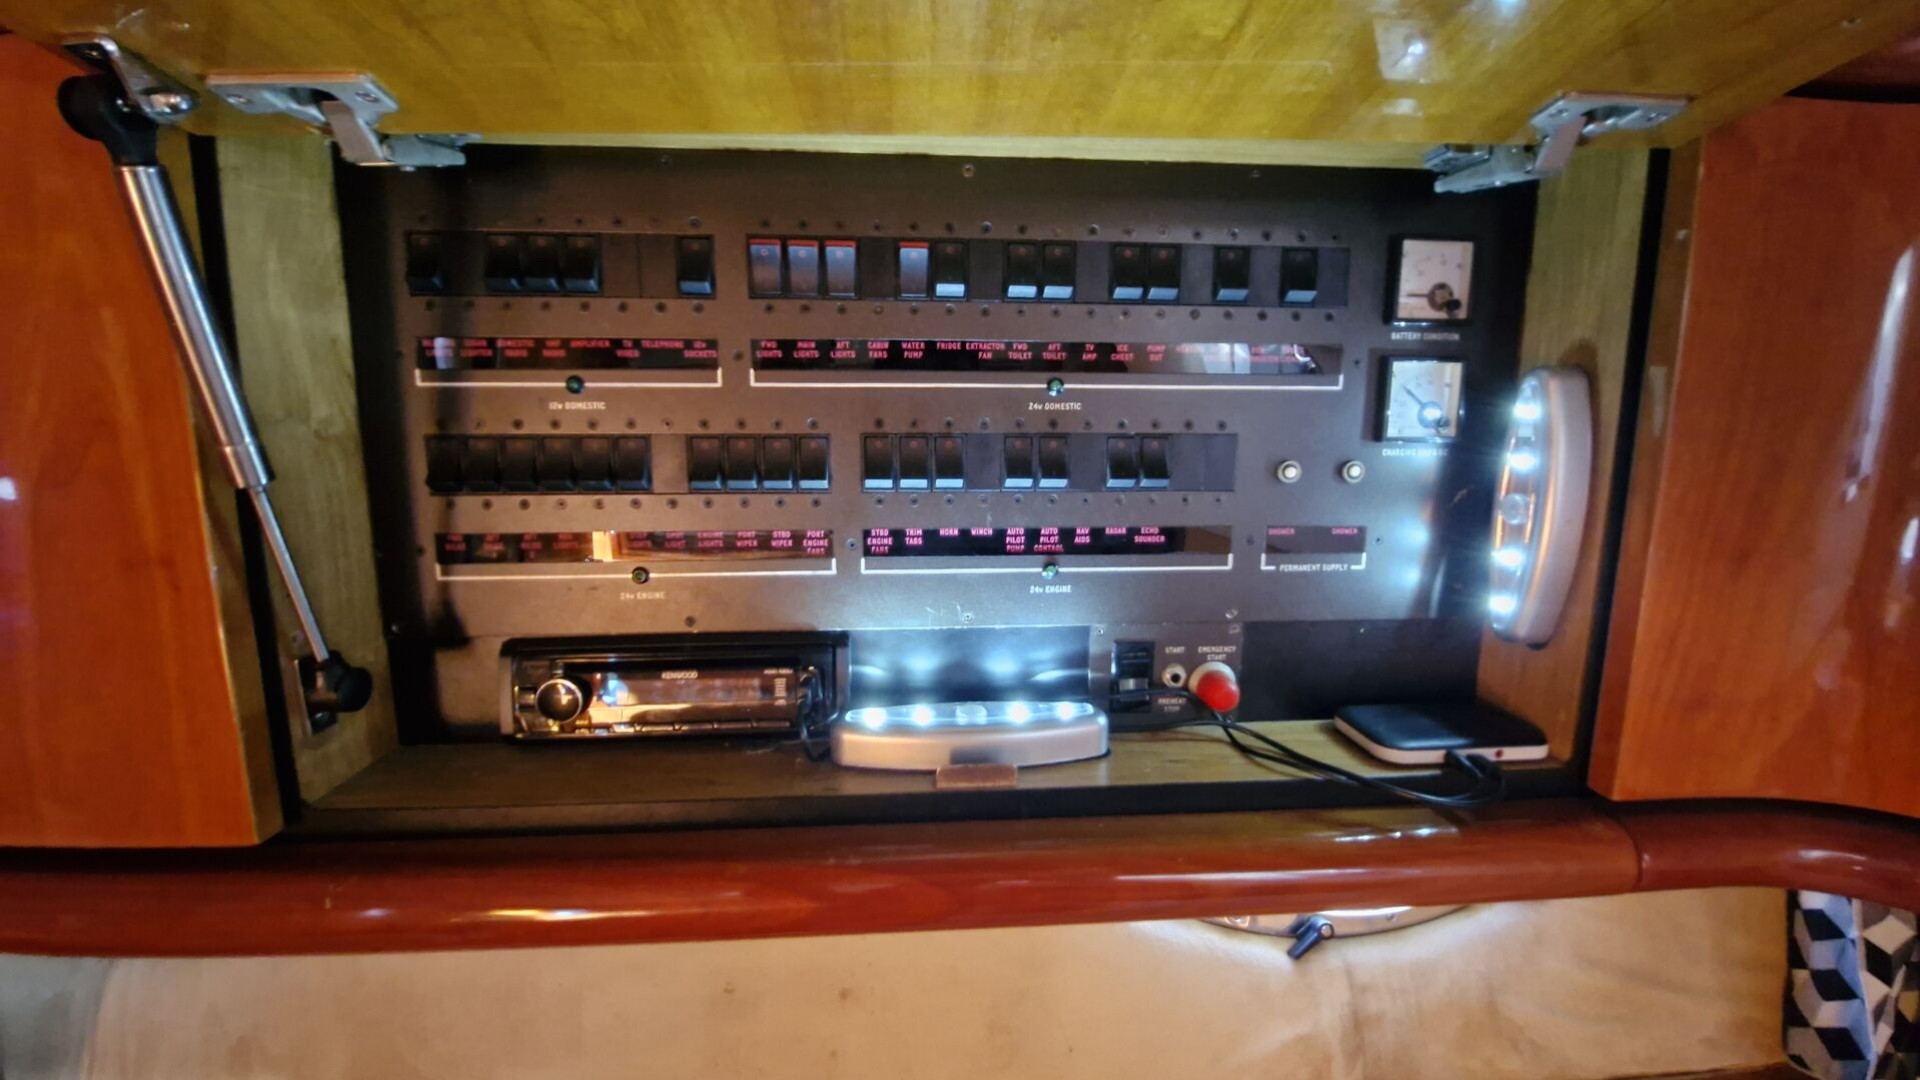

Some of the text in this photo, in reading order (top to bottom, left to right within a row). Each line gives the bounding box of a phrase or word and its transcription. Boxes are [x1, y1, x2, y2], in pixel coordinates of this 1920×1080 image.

[641, 340, 684, 348] TELEPHONE
[797, 340, 816, 349] MAIN
[836, 340, 850, 349] AFT
[867, 341, 889, 349] CABIN
[901, 341, 925, 350] WATER
[936, 342, 961, 350] FRIDGE
[965, 342, 1006, 350] EXTRACTOR
[1012, 342, 1028, 350] FWD
[1047, 342, 1062, 351] AFT
[1085, 343, 1095, 351] TV
[1116, 343, 1129, 352] ICE
[1146, 344, 1166, 352] PUMP
[683, 350, 717, 358] SOCKETS
[756, 349, 782, 358] LIGHTS
[793, 349, 819, 359] LIGHTS
[830, 350, 856, 359] LIGHTS
[869, 350, 888, 359] FANS
[904, 350, 923, 359] PUMP
[978, 351, 992, 359] FAN
[1008, 351, 1033, 360] TOILET
[1042, 351, 1067, 360] TOILET
[1081, 352, 1098, 361] AMP
[1110, 352, 1134, 361] CHEST
[565, 401, 607, 410] DOMESTIC
[1028, 401, 1082, 411] 24v DOMESTIC
[737, 530, 756, 539] PORT
[772, 530, 792, 539] STBD
[806, 530, 825, 539] PORT
[871, 528, 889, 536] STBD
[905, 528, 923, 537] TRIM
[939, 527, 959, 537] HORN
[971, 527, 993, 536] WINCH
[1006, 527, 1025, 536] AUTO
[1040, 527, 1059, 536] AUTO
[1076, 527, 1090, 536] NAV
[1105, 527, 1127, 535] RADAR
[1140, 527, 1159, 535] ECHO
[698, 540, 724, 548] LIGHTS
[735, 539, 758, 548] WIPER
[770, 539, 793, 548] WIPER
[803, 539, 829, 548] ENGINE
[867, 537, 893, 546] ENGINE
[905, 537, 923, 546] TABS
[1006, 536, 1026, 545] PILOT
[1039, 535, 1060, 545] PILOT
[1074, 535, 1091, 544] AIDS
[1134, 535, 1165, 544] SOUNDER
[871, 546, 889, 555] FANS
[1006, 544, 1025, 553] PUMP
[1034, 544, 1064, 553] CONTROL
[1279, 563, 1348, 572] PERMANENT SUPPLY
[1029, 584, 1072, 594] 24v ENGINE
[1165, 646, 1185, 654] START
[1198, 645, 1237, 653] EMERGENCY
[1207, 653, 1227, 661] START
[661, 671, 699, 680] KENWOOD
